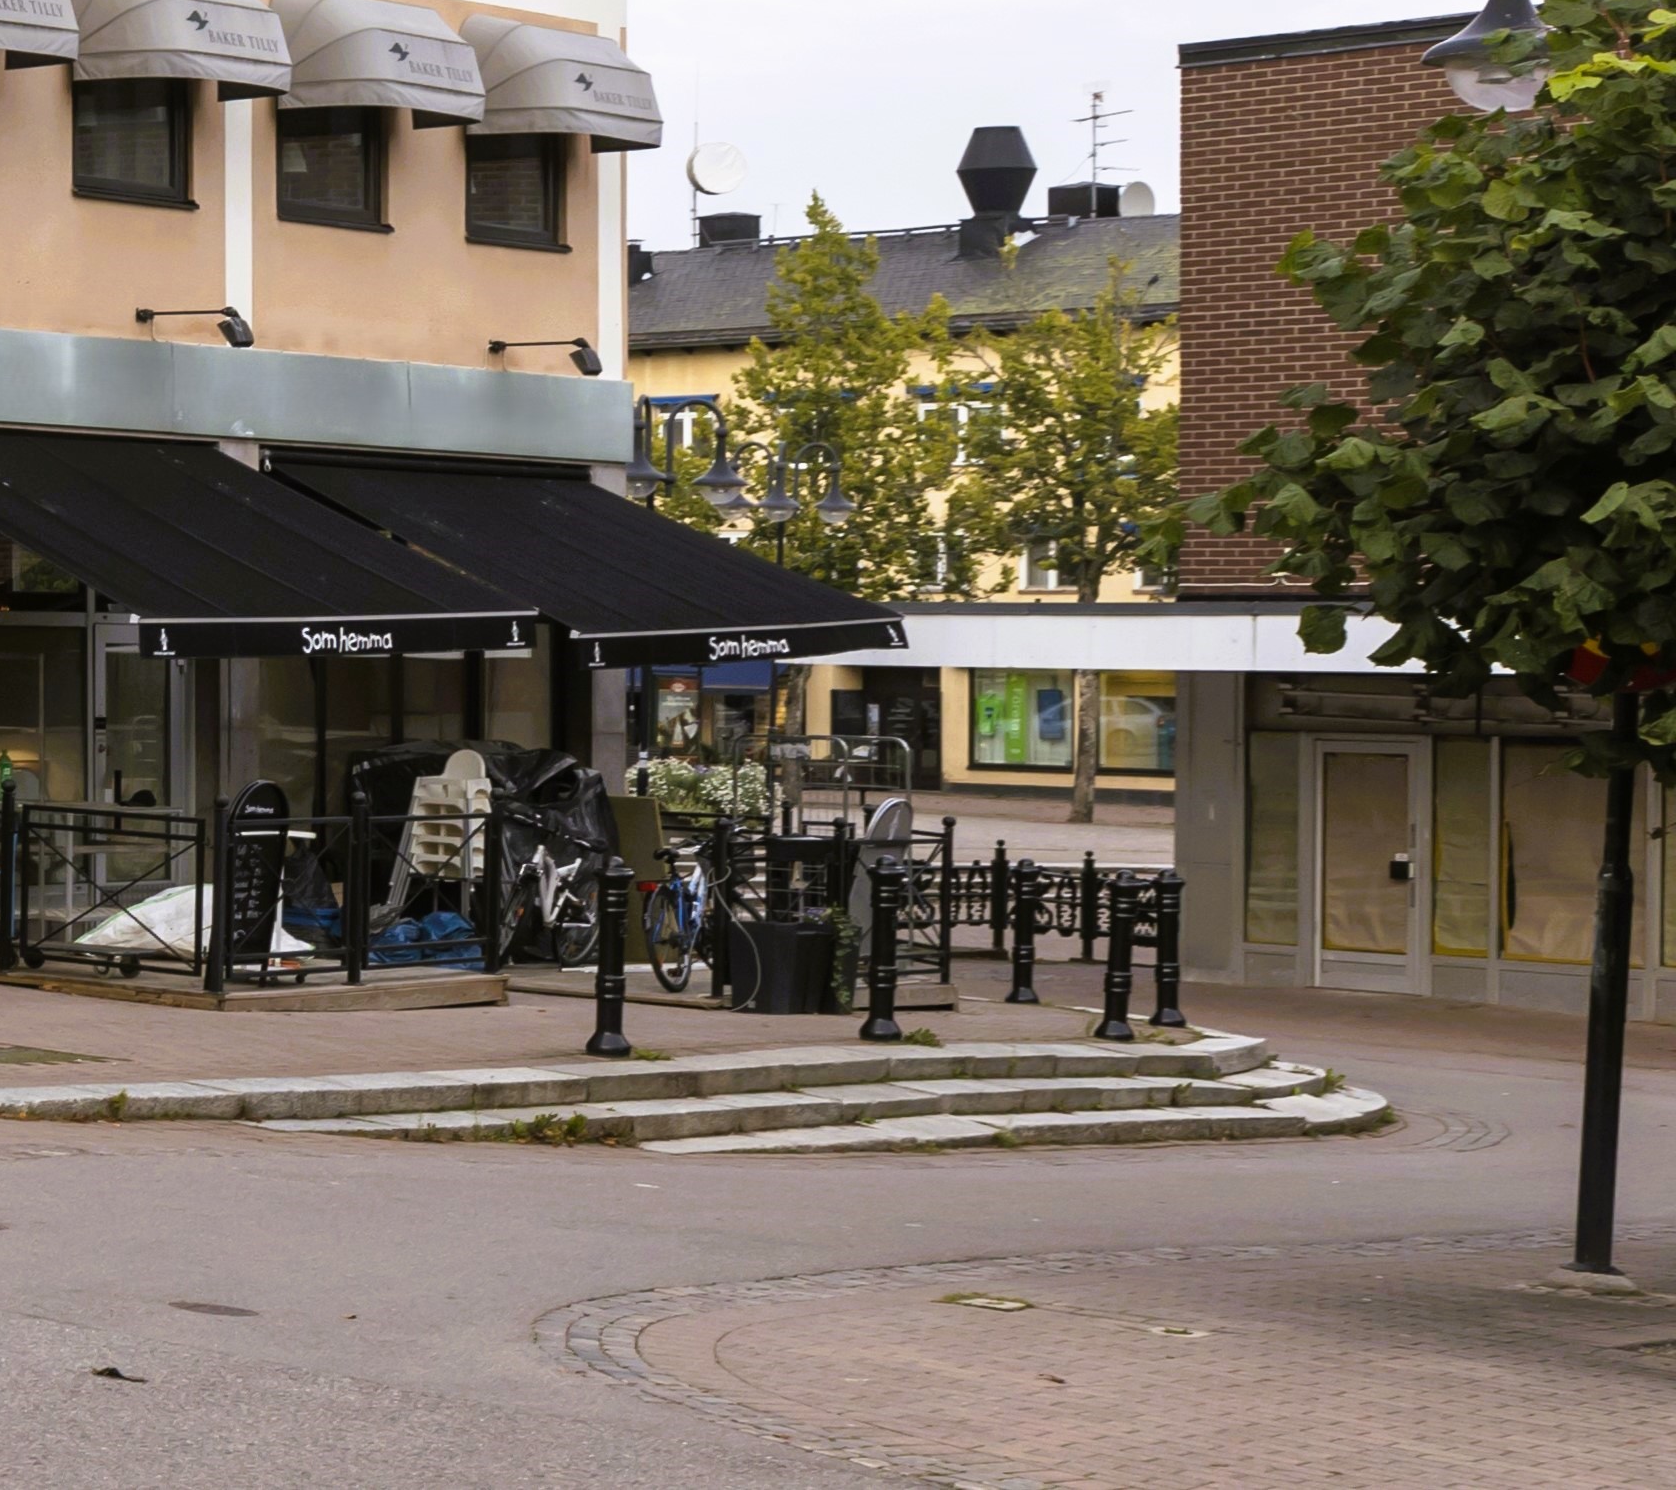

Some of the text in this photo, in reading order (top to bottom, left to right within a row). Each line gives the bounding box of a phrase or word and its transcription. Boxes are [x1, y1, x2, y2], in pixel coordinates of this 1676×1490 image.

[207, 28, 279, 54] BAKER TILLY
[409, 59, 473, 83] BAKER TILLY
[592, 89, 625, 106] BAKER
[301, 626, 393, 654] Som hemma
[709, 634, 790, 660] Som hemma
